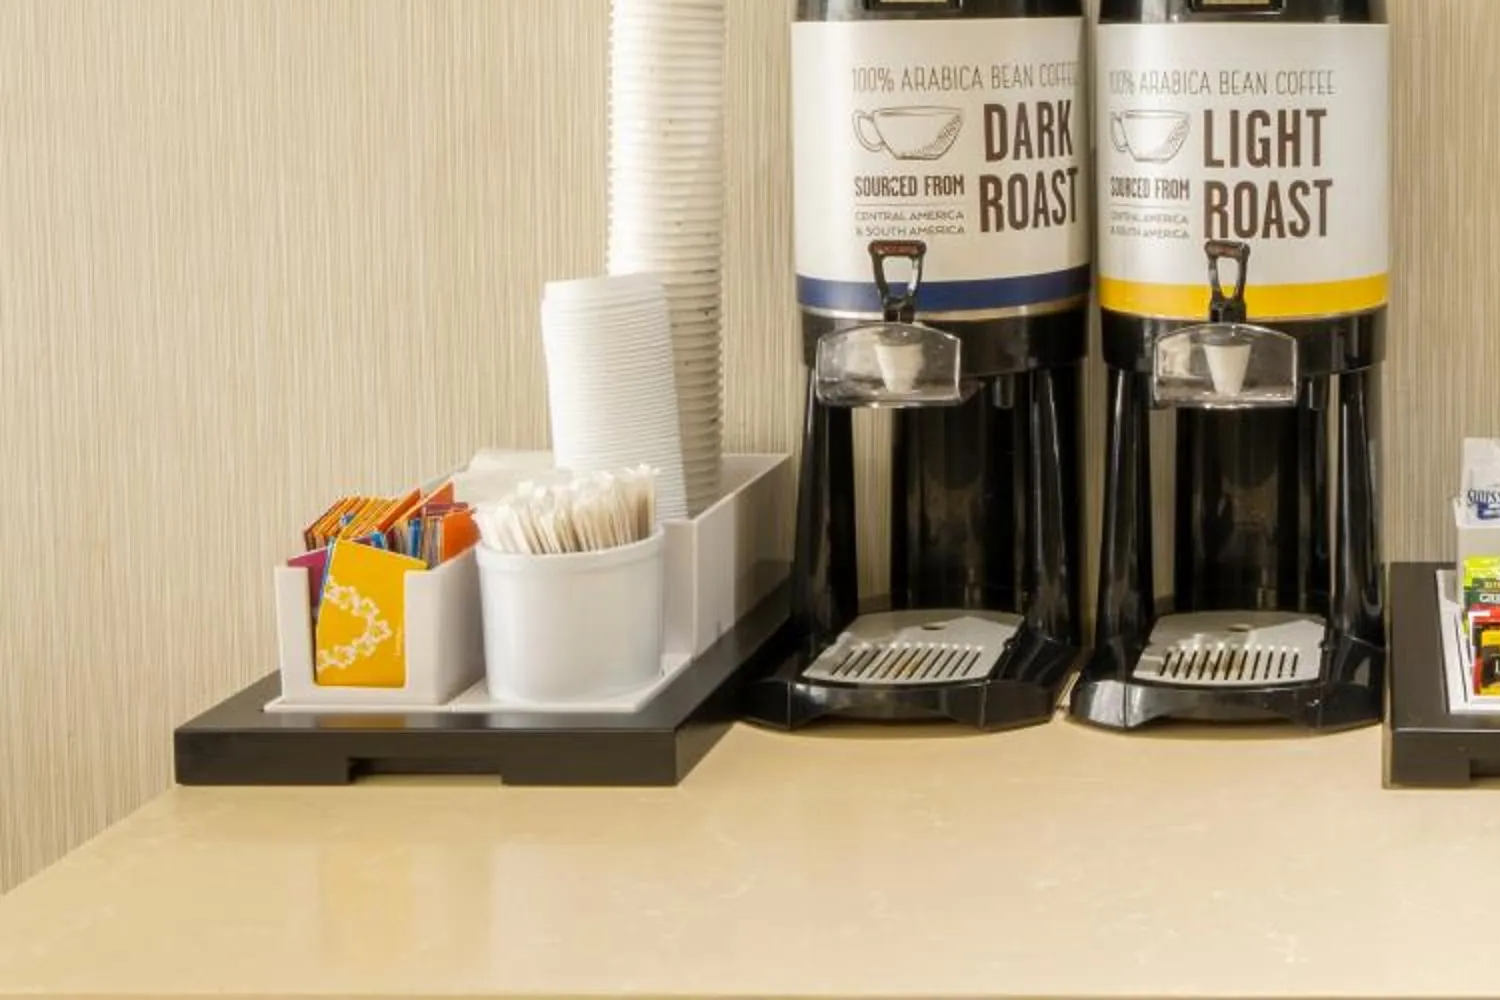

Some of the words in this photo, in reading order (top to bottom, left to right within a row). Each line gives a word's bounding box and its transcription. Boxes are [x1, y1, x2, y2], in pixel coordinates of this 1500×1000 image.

[852, 67, 894, 92] 100%
[901, 65, 983, 91] ARABICA
[992, 63, 1033, 88] BEAN
[1140, 70, 1211, 96] ARABICA
[1219, 71, 1268, 95] BEAN
[1276, 71, 1337, 95] COFFEE
[984, 100, 1073, 162] DARK
[1204, 108, 1327, 168] LIGHT
[855, 175, 917, 197] SOURCED
[924, 174, 964, 196] FROM
[1155, 177, 1190, 200] FROM
[980, 166, 1078, 233] ROAST
[1204, 178, 1333, 239] ROAST
[910, 209, 964, 221] AMERICA
[866, 225, 906, 237] SOUTH
[909, 224, 965, 235] AMERICA
